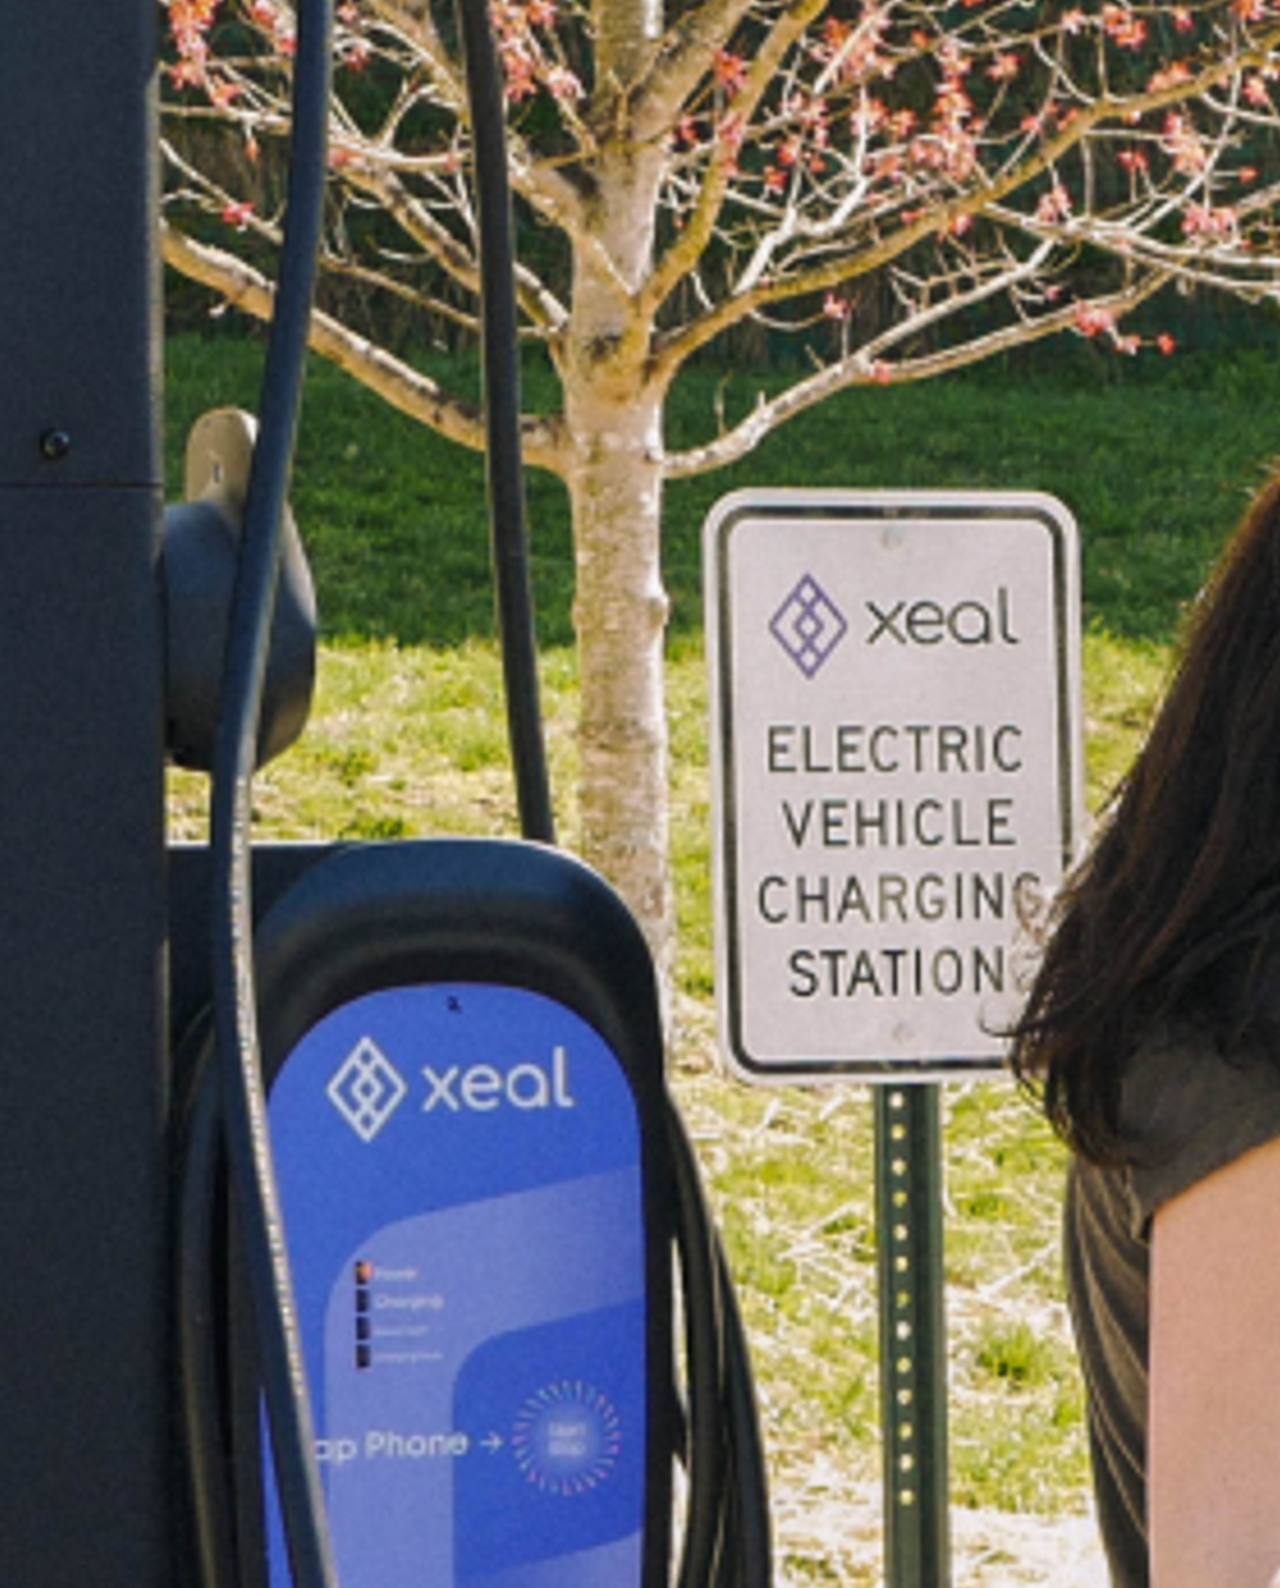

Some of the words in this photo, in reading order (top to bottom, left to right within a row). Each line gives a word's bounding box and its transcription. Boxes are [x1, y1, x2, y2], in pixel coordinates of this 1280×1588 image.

[865, 587, 1019, 645] xeal
[768, 726, 1022, 773] ELECTRIC
[782, 799, 1017, 847] VEHICLE
[788, 949, 1005, 998] STATION
[422, 1045, 574, 1111] xeal
[314, 1438, 357, 1466] ap
[365, 1430, 469, 1457] Phone
